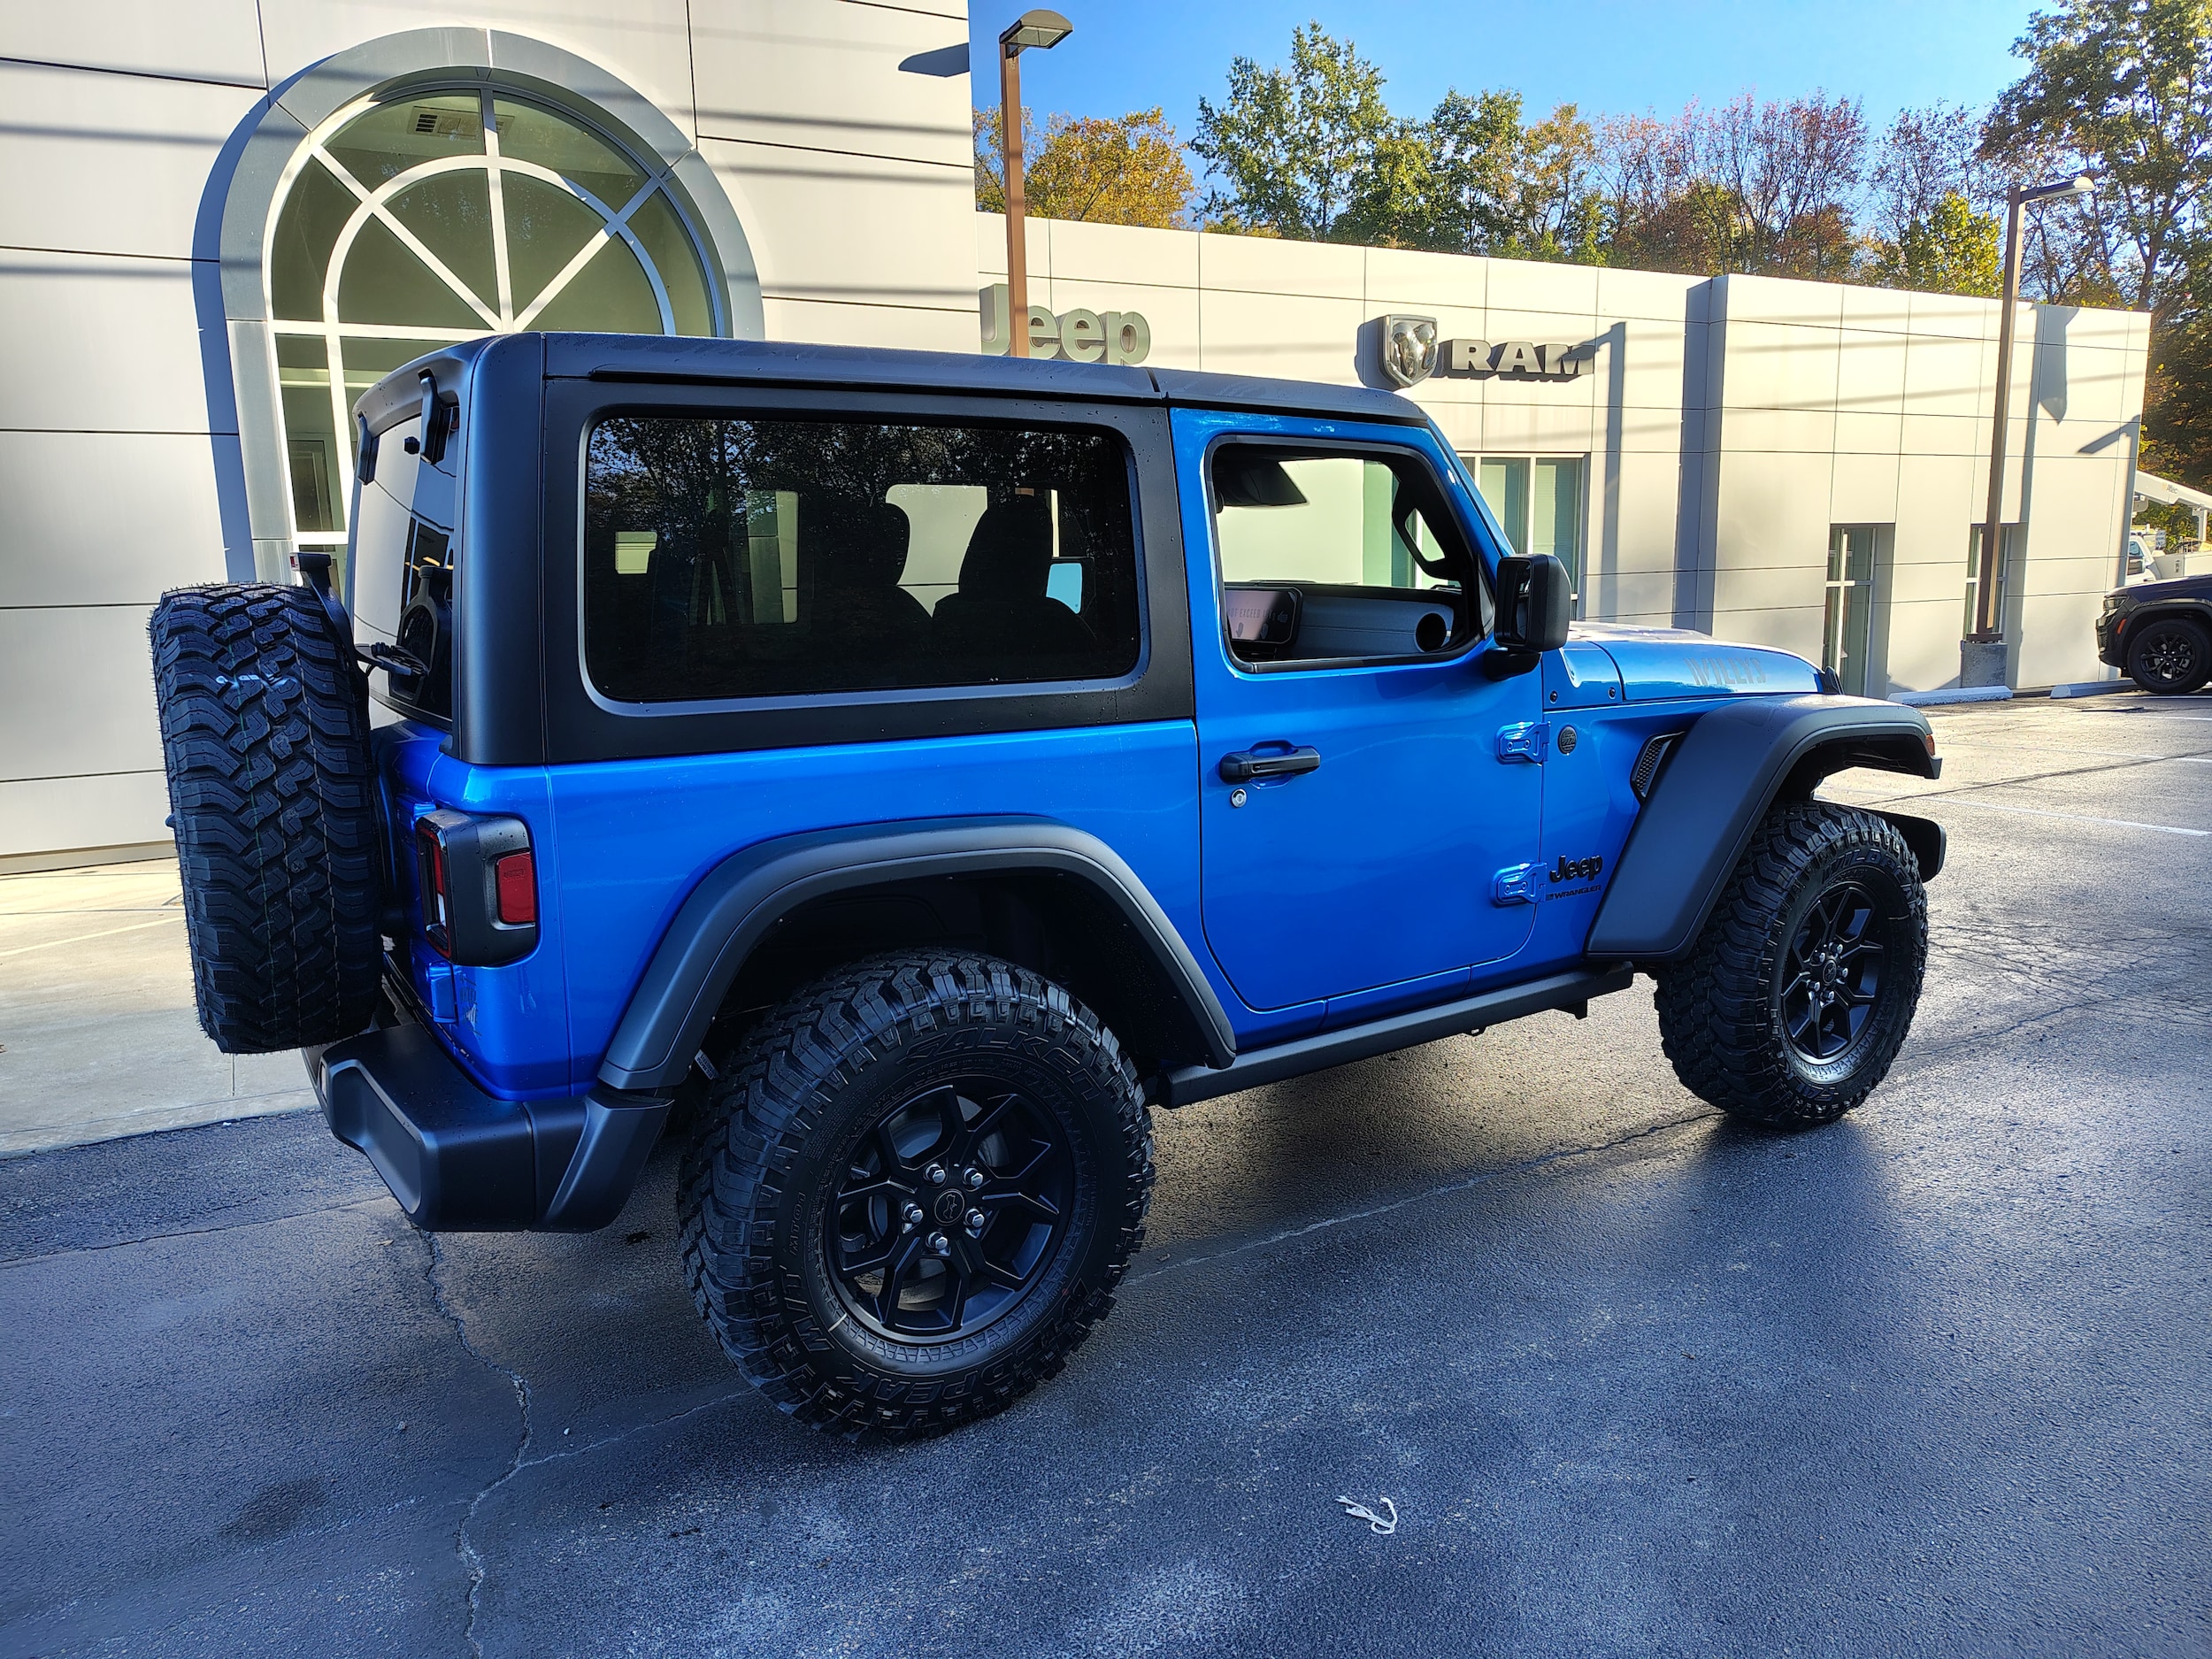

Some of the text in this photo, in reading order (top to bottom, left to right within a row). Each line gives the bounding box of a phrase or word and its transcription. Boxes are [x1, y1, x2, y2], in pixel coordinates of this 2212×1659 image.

[979, 283, 1151, 365] Jeep
[1451, 339, 1594, 375] RAM
[1684, 657, 1766, 686] WILLYS
[1549, 855, 1603, 883] Jeep
[1554, 885, 1601, 899] WRANGLER
[896, 1027, 1102, 1102] FALKEN
